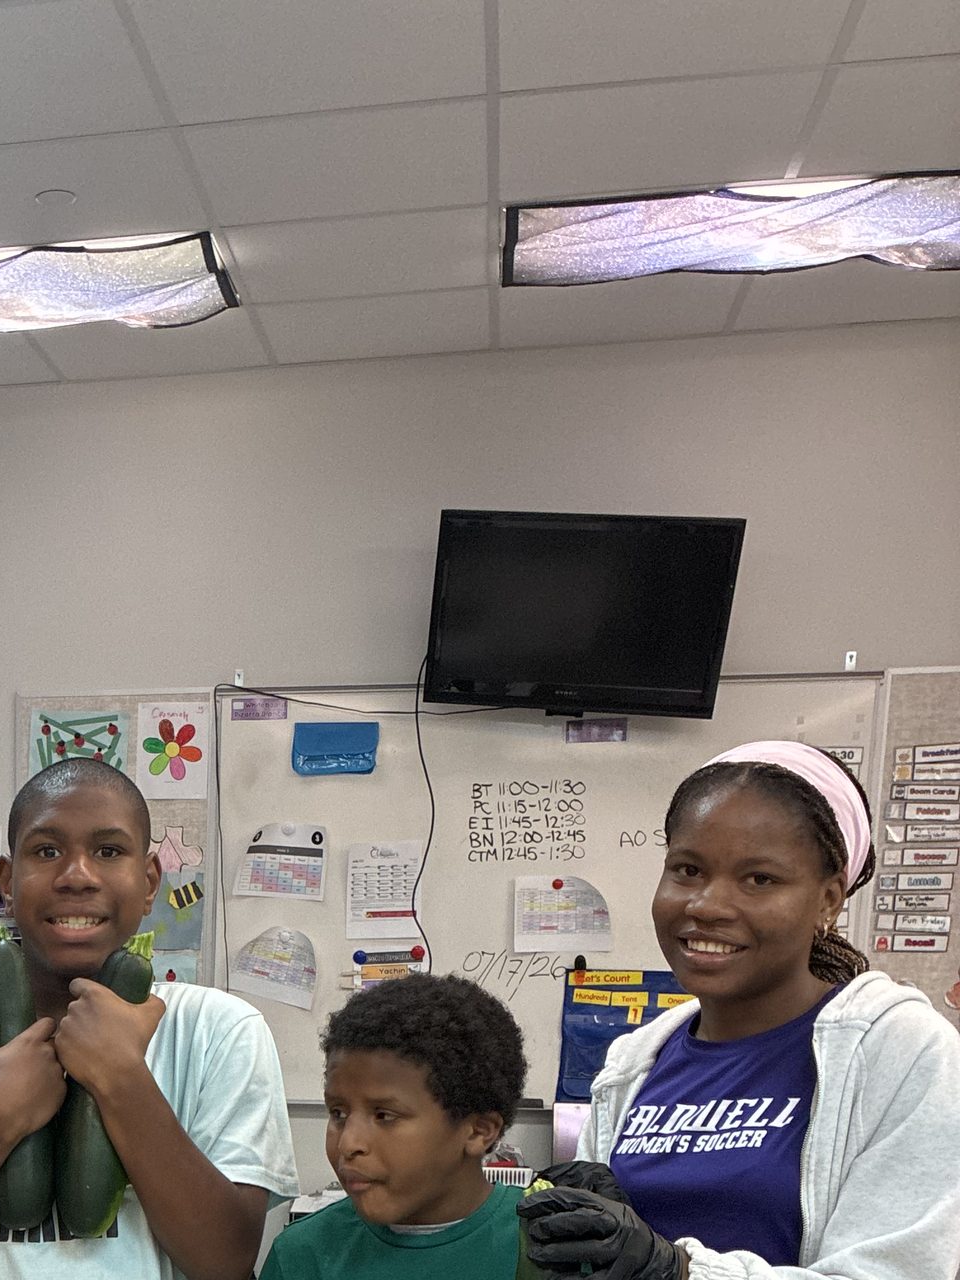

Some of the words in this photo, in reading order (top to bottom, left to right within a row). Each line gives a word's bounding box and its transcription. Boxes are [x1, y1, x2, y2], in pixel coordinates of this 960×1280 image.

[471, 783, 493, 799] BT
[498, 779, 587, 796] 11:00-11:30
[473, 801, 492, 815] PC
[497, 798, 584, 814] 11:15-12:00
[469, 832, 494, 848] BN
[501, 829, 586, 846] 12:00-12:45
[468, 848, 498, 863] CTM
[603, 974, 631, 983] Count
[575, 991, 609, 1002] Hundreds
[621, 995, 638, 1003] Tens
[623, 1097, 801, 1136] ALDWELL
[616, 1134, 692, 1155] WOMEN'S
[692, 1129, 768, 1153] SOCCER
